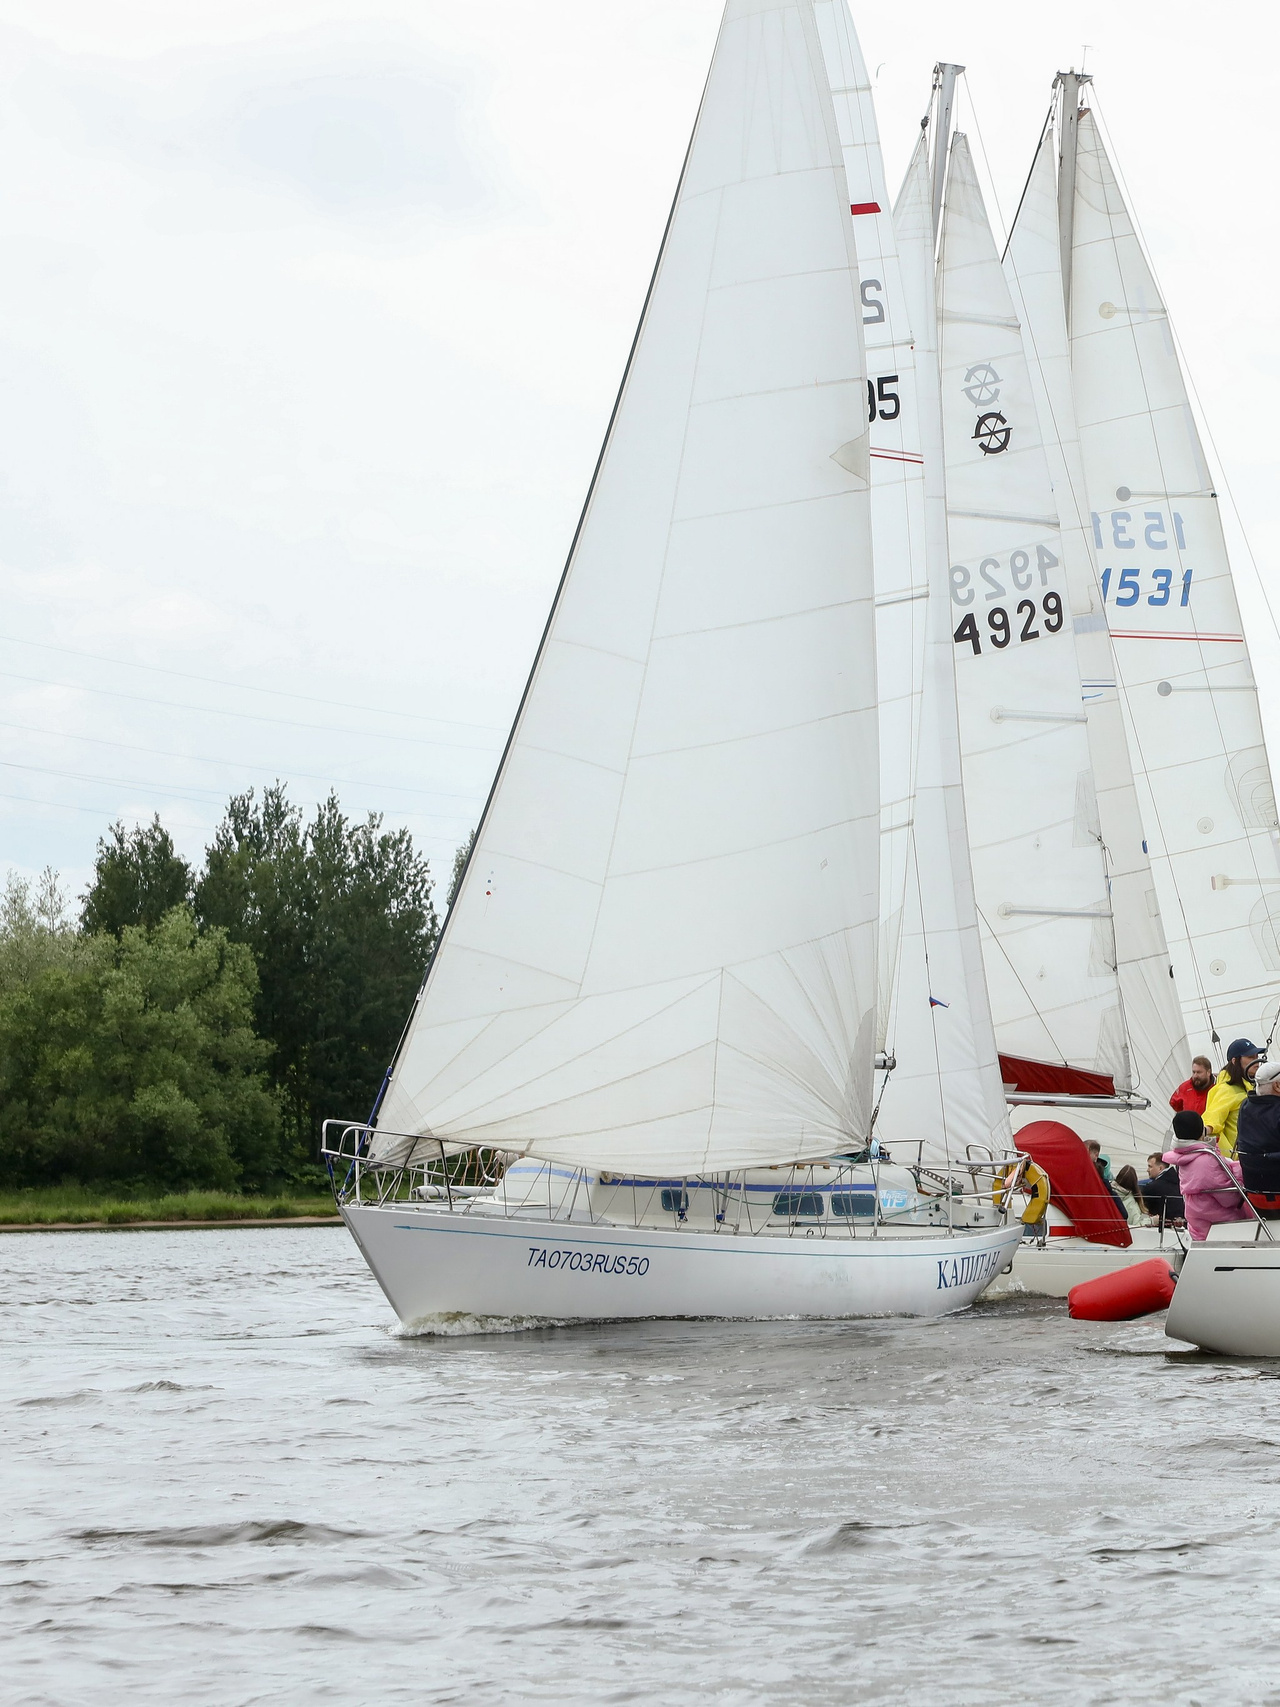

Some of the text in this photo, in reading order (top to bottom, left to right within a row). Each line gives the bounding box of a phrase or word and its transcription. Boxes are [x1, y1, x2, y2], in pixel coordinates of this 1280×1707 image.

[1100, 568, 1193, 607] 1531
[953, 591, 1064, 655] 4929
[936, 1250, 1001, 1290] КАПИТАН
